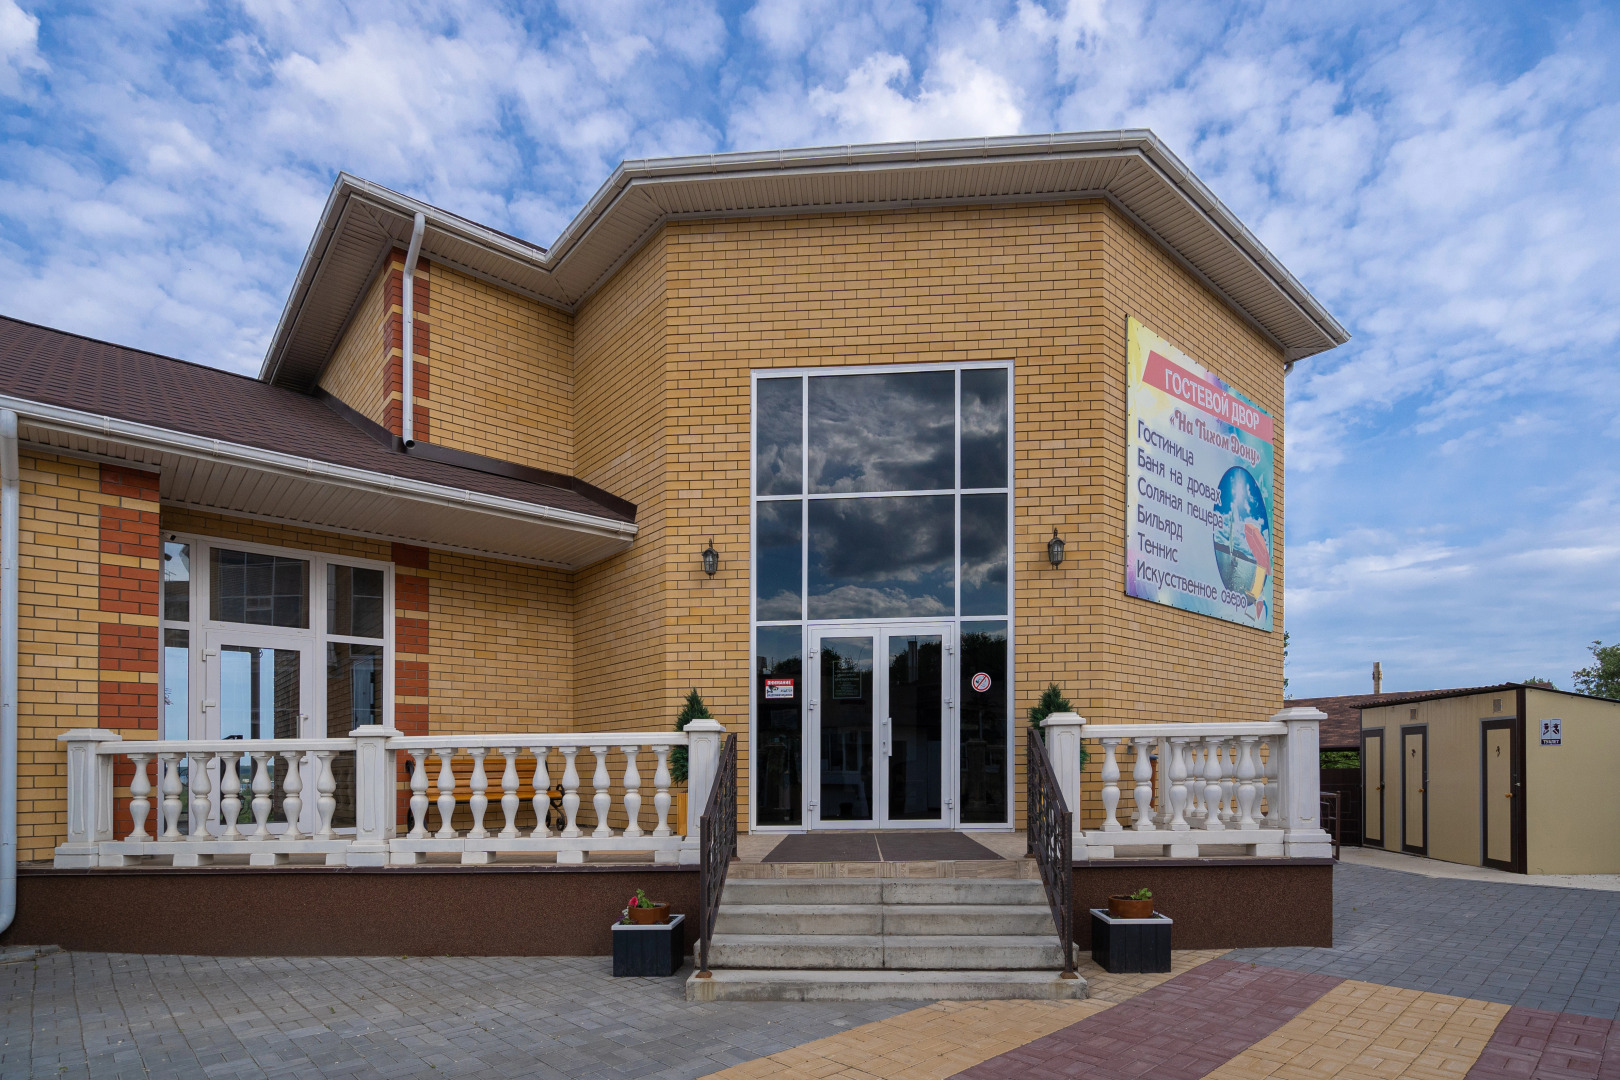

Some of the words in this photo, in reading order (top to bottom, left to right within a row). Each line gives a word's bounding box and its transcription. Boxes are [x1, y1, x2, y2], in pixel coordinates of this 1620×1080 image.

[1165, 368, 1229, 418] ГОСТЕВОЙ
[1231, 404, 1260, 430] ДВОР
[1138, 420, 1194, 466] Гостиница
[1195, 418, 1229, 450] Тихом
[1138, 448, 1165, 478] Баня
[1170, 468, 1183, 486] на
[1187, 477, 1222, 504] дровах
[1137, 477, 1183, 512] Соляная
[1187, 502, 1223, 531] пещера
[1137, 504, 1183, 542] Бильярд
[1137, 532, 1178, 563] Теннис
[1137, 560, 1218, 600] Искусственное
[1221, 590, 1247, 612] озеро
